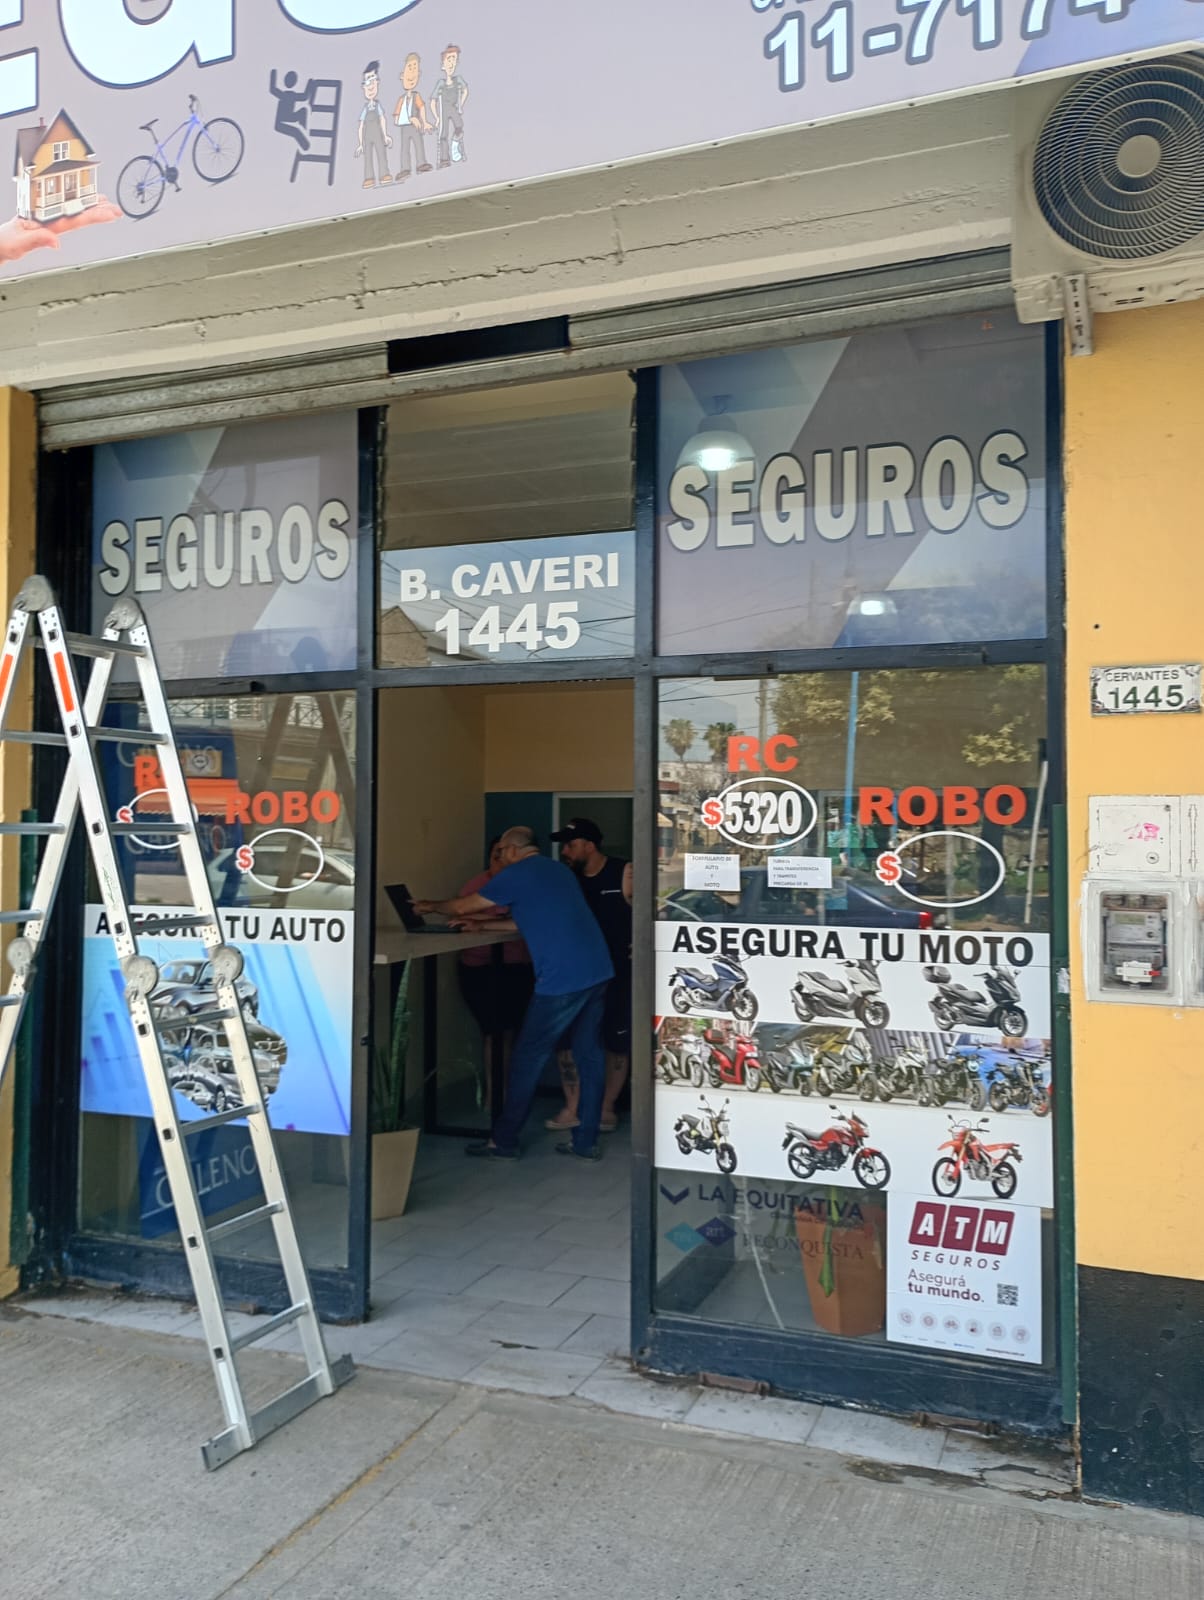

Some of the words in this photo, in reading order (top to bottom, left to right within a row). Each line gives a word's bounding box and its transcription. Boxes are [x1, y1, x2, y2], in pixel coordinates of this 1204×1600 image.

[764, 0, 1130, 91] 11-717
[666, 430, 1029, 551] SEGUROS
[99, 498, 352, 596] SEGUROS
[399, 568, 441, 602] B.
[451, 552, 619, 599] CAVERI
[434, 601, 581, 656] 1445
[1105, 669, 1179, 683] CERVANTES
[1109, 685, 1184, 709] 1445
[727, 734, 799, 772] RC
[224, 790, 340, 825] ROBO
[858, 785, 1027, 826] ROBO
[236, 845, 255, 872] $
[876, 851, 902, 885] $
[225, 914, 260, 939] TU
[270, 916, 347, 943] AUTO
[671, 924, 845, 960] ASEGURA
[859, 931, 905, 962] TU
[918, 933, 1034, 968] MOTO
[156, 1145, 256, 1208] LENO
[698, 1183, 726, 1201] LA
[734, 1189, 864, 1220] EQUITATIVA
[916, 1212, 1009, 1246] ATM
[907, 1268, 967, 1288] Asegurá
[911, 1249, 1001, 1271] SEGUROS
[907, 1281, 923, 1294] tu
[927, 1286, 985, 1303] mundo.
